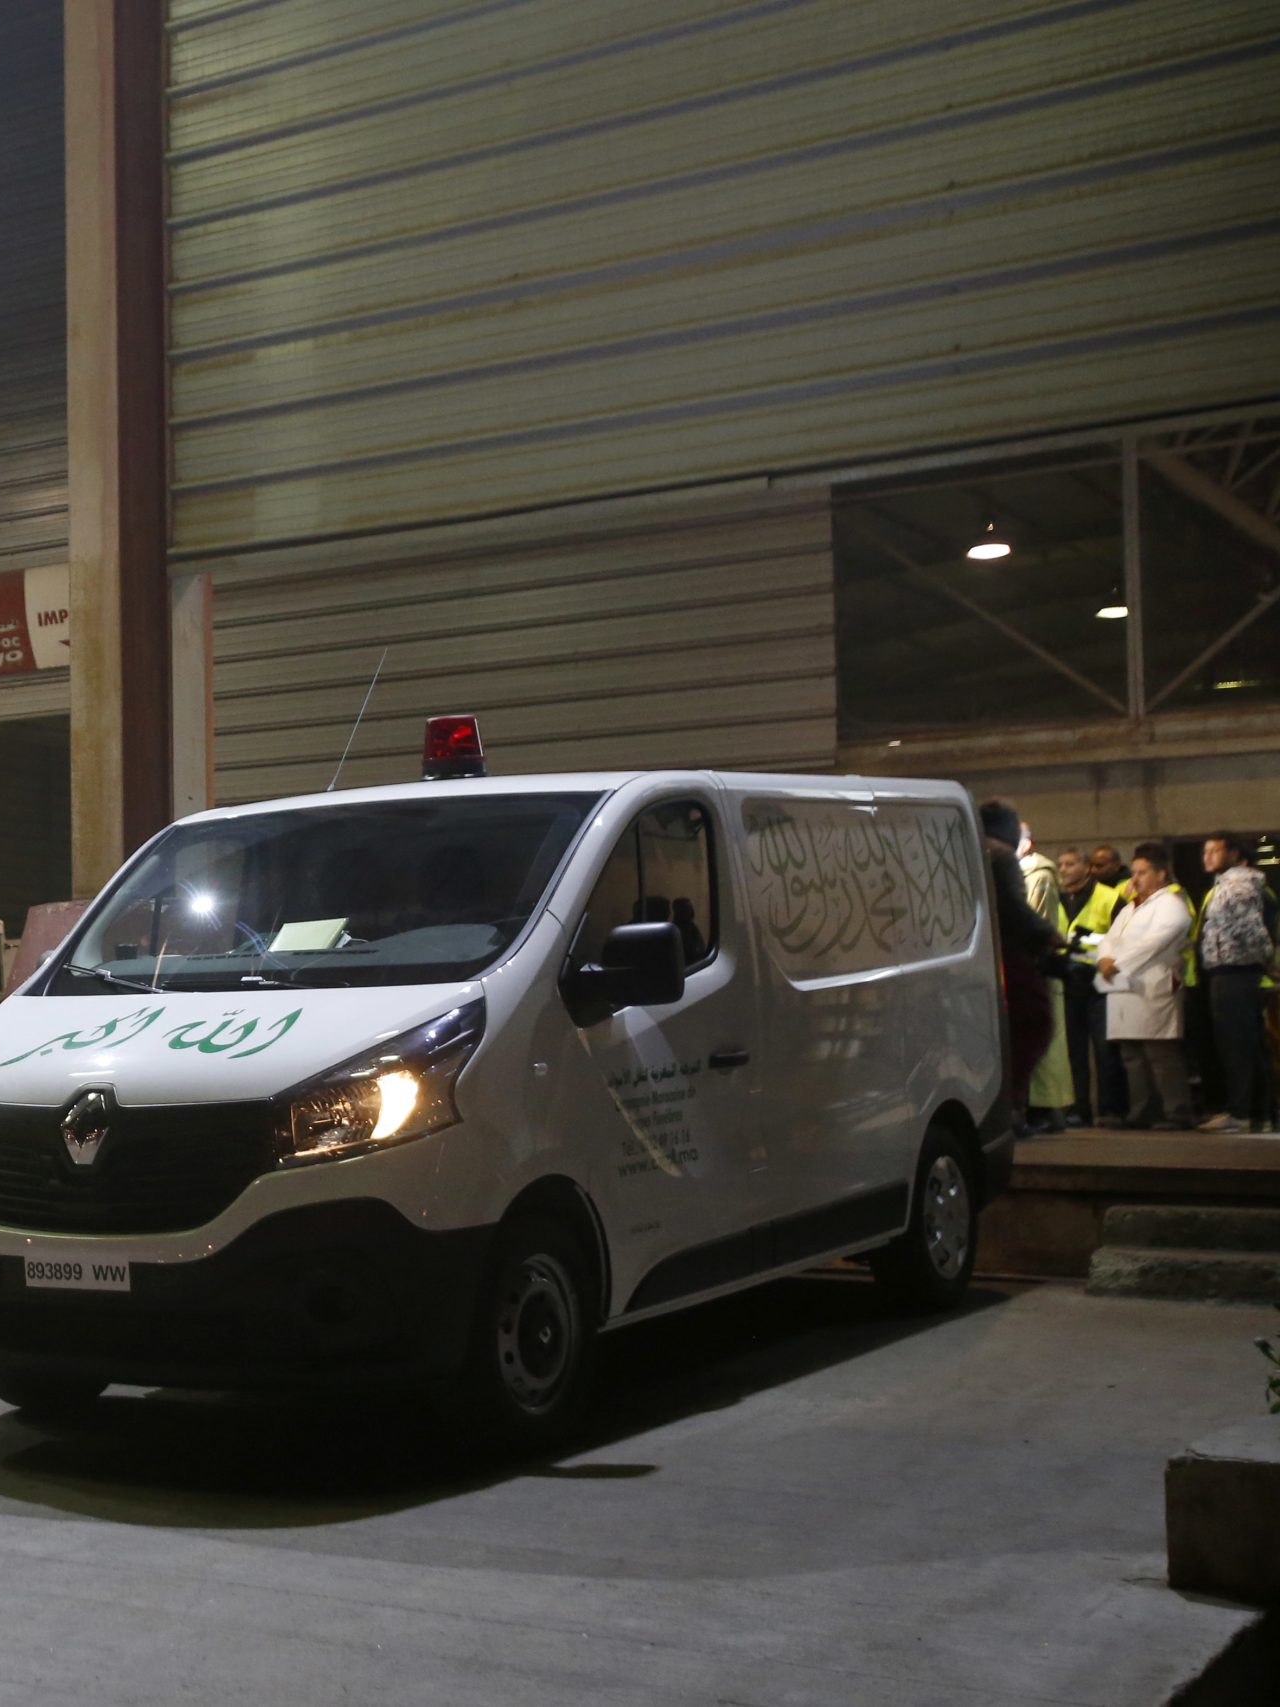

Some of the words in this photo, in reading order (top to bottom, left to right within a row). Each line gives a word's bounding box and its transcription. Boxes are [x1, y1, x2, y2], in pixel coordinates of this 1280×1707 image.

[37, 608, 70, 627] IMP
[162, 1007, 304, 1060] الله
[27, 1261, 83, 1281] 893899
[92, 1263, 127, 1282] WW
